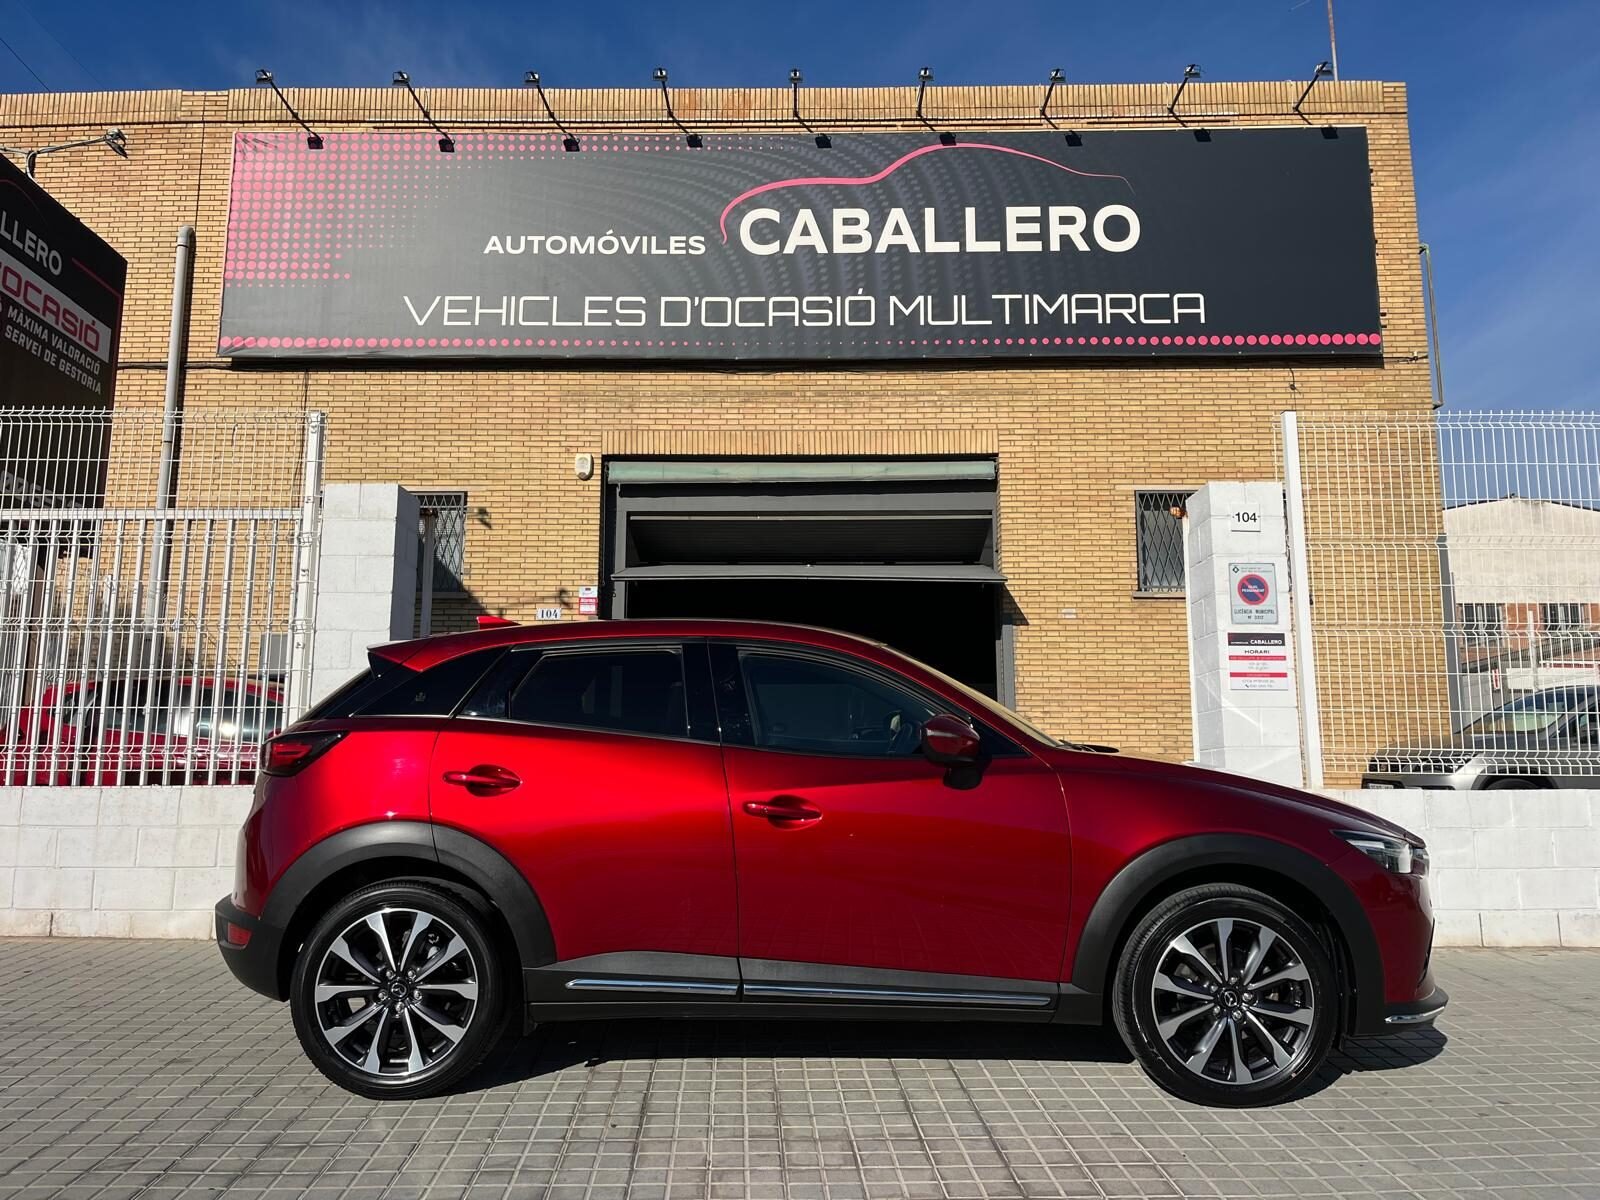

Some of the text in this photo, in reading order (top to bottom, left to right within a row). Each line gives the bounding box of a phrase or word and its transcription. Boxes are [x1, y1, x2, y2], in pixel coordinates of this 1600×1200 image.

[482, 204, 1141, 256] AUTOMÓVILES CABALLERO
[404, 287, 1206, 328] VEHICLES D'OCASIÓ MULTIMARCA
[5, 324, 101, 395] SERVEI DE GESTORIA
[51, 332, 101, 377] VALORACIÓ
[1235, 512, 1258, 523] 104
[541, 609, 557, 618] 104
